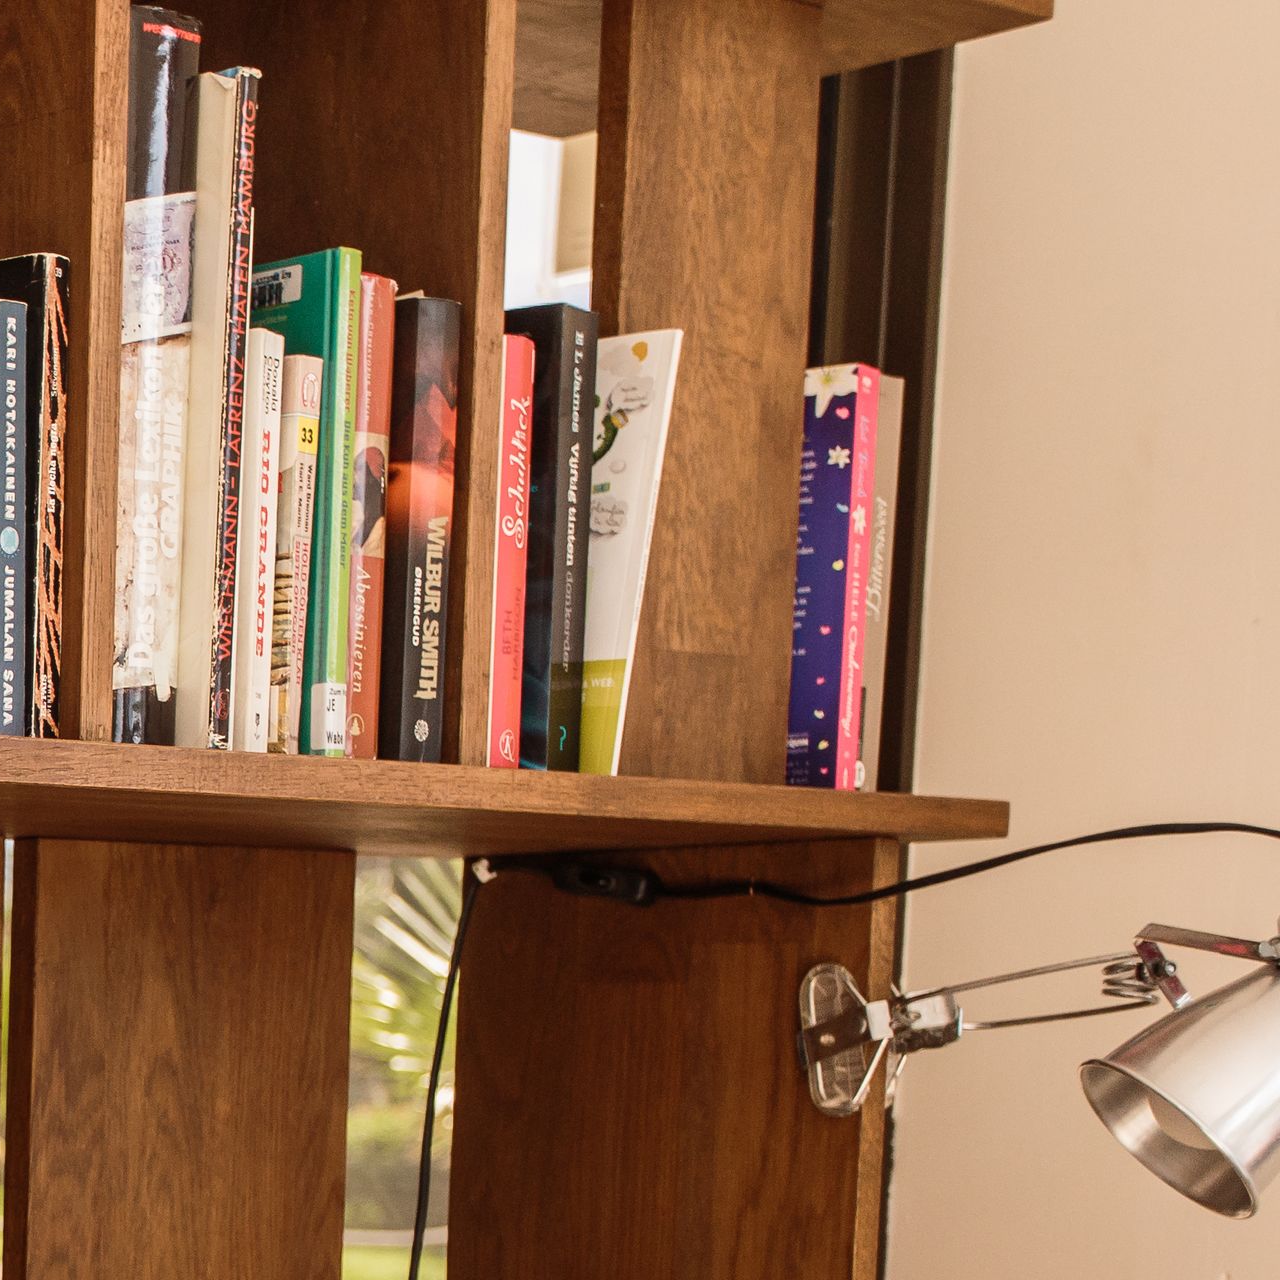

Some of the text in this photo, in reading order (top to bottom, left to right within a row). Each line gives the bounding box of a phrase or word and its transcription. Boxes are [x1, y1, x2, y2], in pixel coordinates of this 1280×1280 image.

[216, 100, 258, 661] WIECHMANN LAFRENZ HAFEN HAMBURG
[264, 355, 274, 415] Clayton
[271, 357, 280, 413] Donald
[572, 367, 583, 433] James
[4, 316, 17, 521] KARI HOTAKAINEN
[300, 427, 314, 445] 33
[304, 464, 314, 533] Ward Brennan
[255, 429, 271, 658] RIO GRANDE
[293, 541, 302, 581] SISTE
[567, 507, 578, 567] tinten
[295, 542, 309, 686] HOLD COLTEN KLAR
[351, 565, 371, 694] Abessinieren
[413, 516, 450, 700] WILBUR SMITH
[502, 609, 513, 655] BETH
[2, 565, 16, 727] JUMALAN SANA
[326, 698, 336, 711] JE
